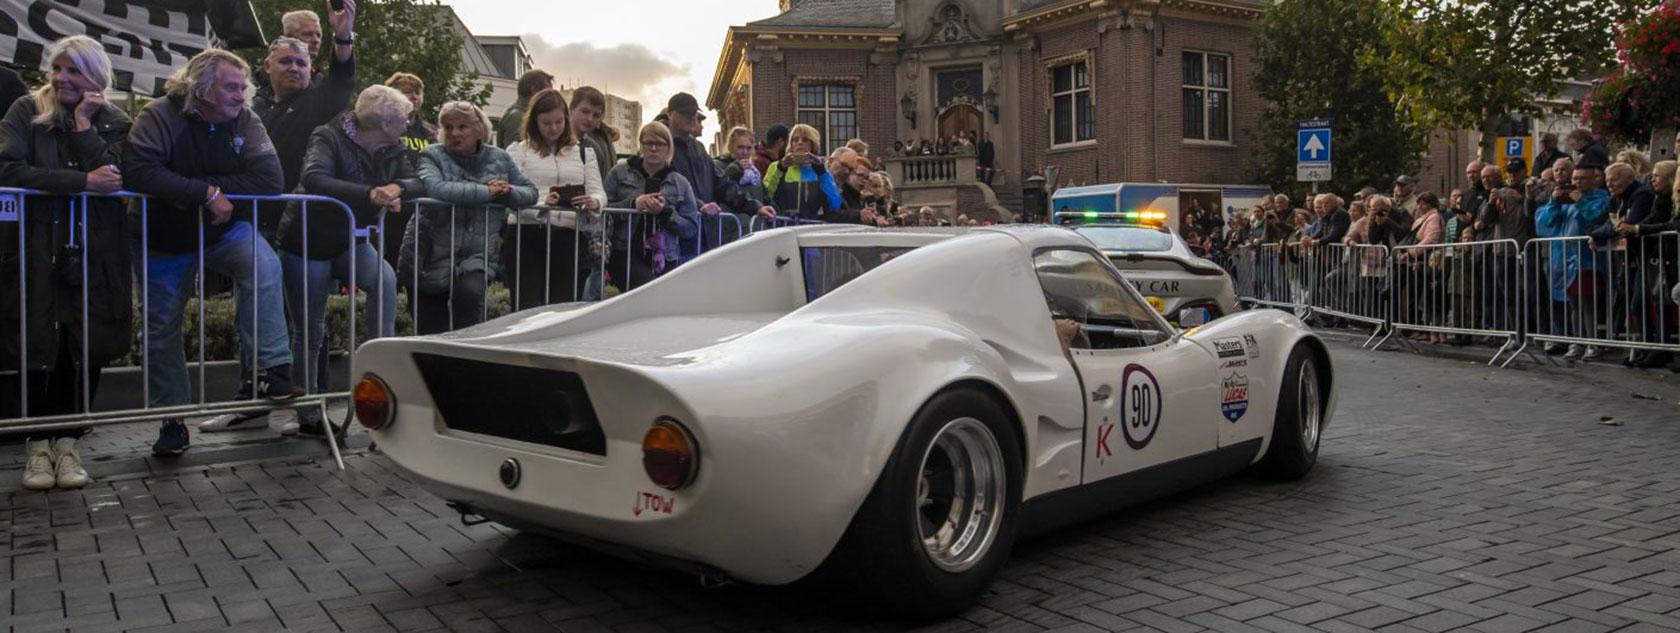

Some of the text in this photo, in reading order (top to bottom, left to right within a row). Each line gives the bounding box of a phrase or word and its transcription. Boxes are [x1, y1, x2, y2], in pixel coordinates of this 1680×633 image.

[1509, 140, 1520, 155] P
[1149, 280, 1181, 293] CAR
[1132, 383, 1151, 429] 90
[1096, 424, 1114, 458] K
[642, 492, 674, 514] TOW
